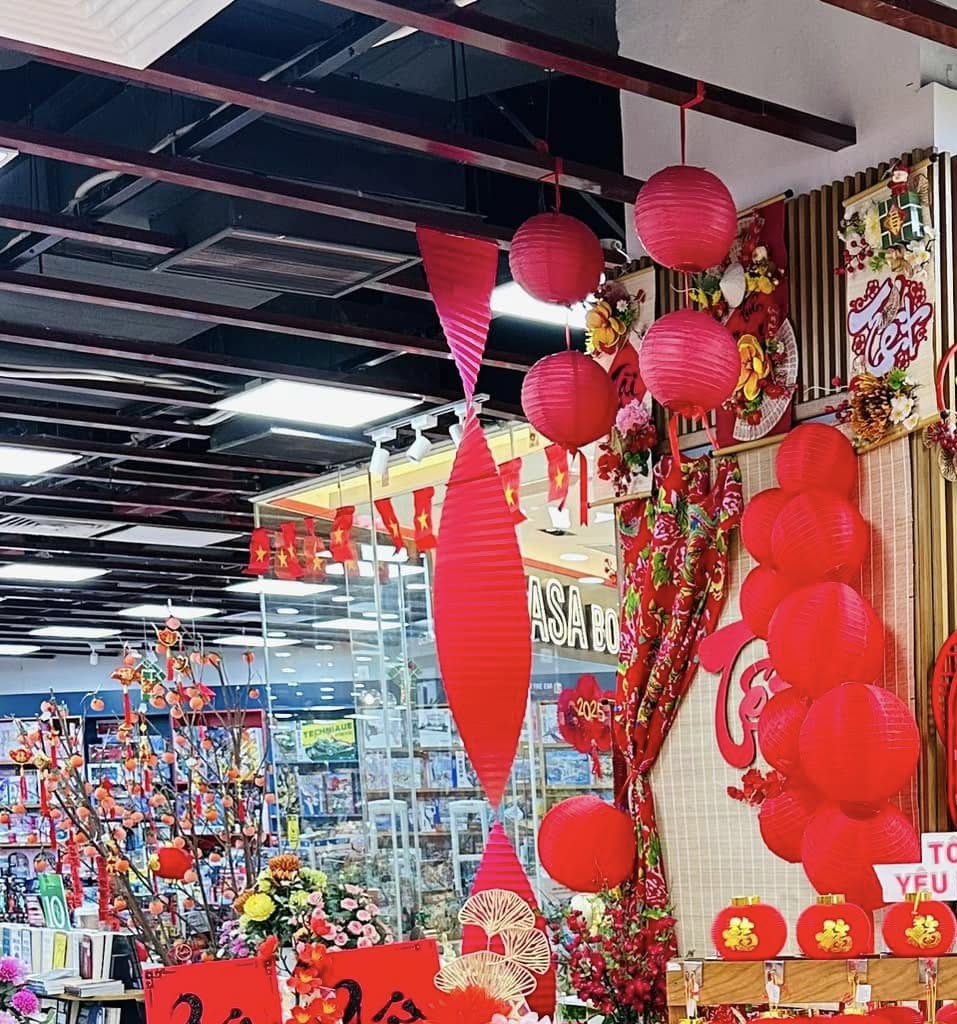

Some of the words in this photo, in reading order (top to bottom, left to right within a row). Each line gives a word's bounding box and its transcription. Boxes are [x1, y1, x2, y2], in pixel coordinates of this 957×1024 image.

[528, 576, 588, 649] ASA
[590, 604, 620, 654] BO
[576, 697, 606, 721] 2025
[895, 867, 948, 894] YÊU
